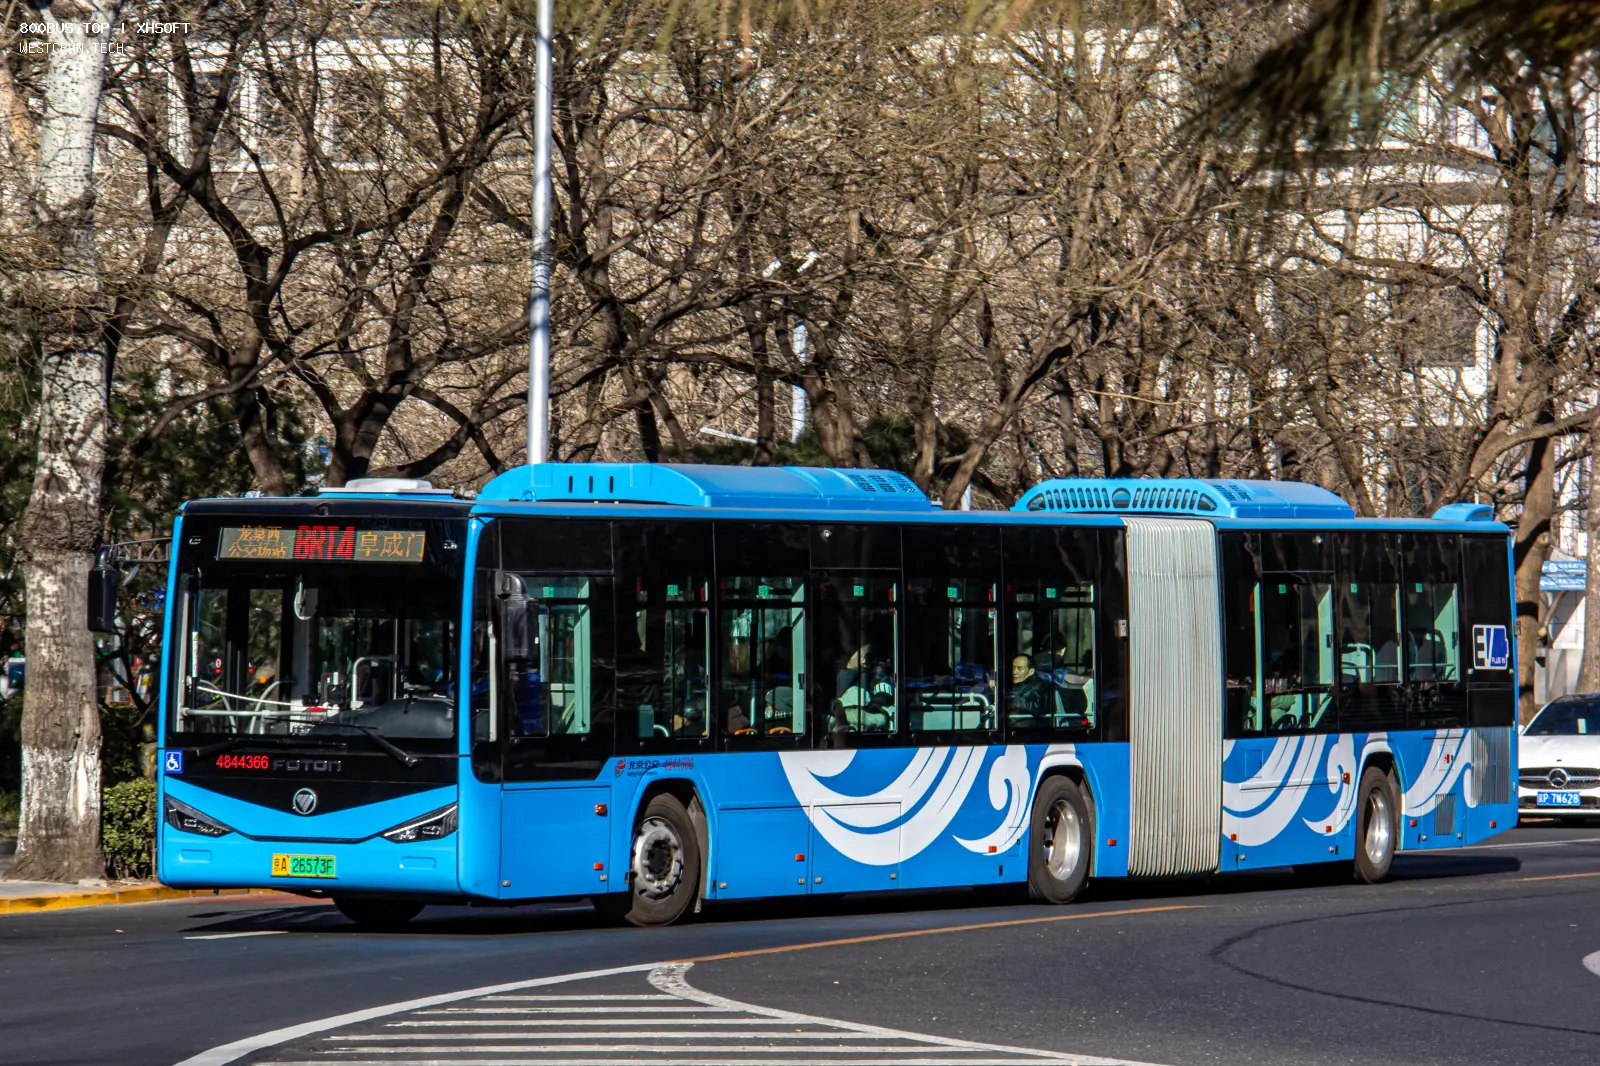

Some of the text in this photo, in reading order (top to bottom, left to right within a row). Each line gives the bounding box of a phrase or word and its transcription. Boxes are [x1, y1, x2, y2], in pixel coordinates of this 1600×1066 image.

[228, 541, 287, 558] 公交场站
[295, 525, 355, 560] BRT4
[358, 531, 426, 558] 阜成门
[215, 755, 341, 771] 4844366 FOTON
[628, 760, 659, 770] 北京公交
